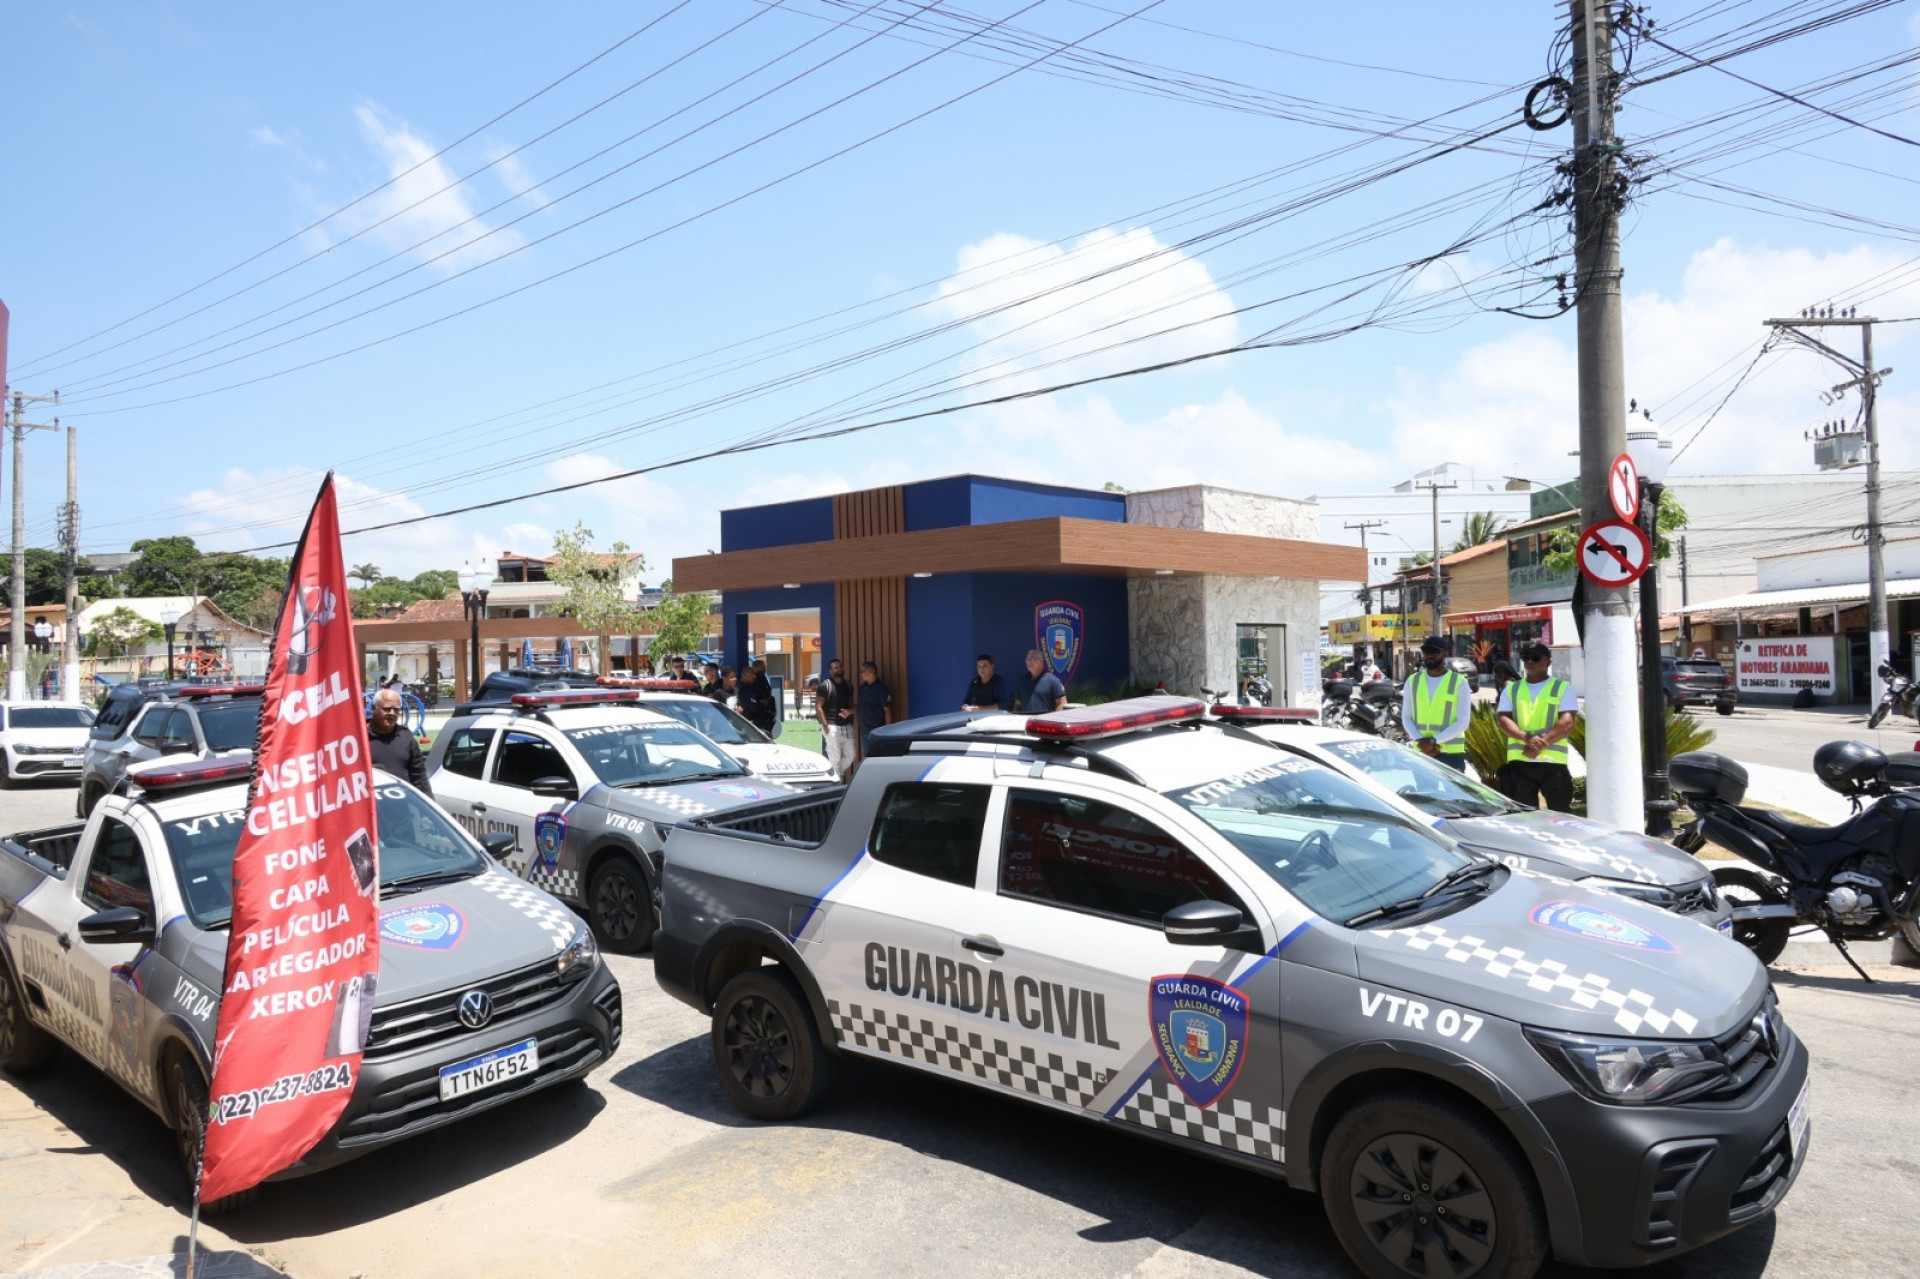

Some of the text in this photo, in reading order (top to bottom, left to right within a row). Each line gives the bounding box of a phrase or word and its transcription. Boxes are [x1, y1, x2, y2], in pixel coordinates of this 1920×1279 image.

[1040, 606, 1080, 620] GUARDA CIVIL
[1740, 661, 1830, 674] MOTORES ARARUAMA
[1758, 644, 1794, 657] RETIFICA
[1796, 644, 1807, 657] DE
[277, 671, 350, 726] CELL
[570, 728, 604, 740] VTR
[257, 735, 360, 797] NSERTO
[247, 770, 370, 836] CELULAR
[1182, 781, 1236, 805] VTR
[605, 812, 646, 834] VTR 06
[265, 838, 327, 875] FONE
[269, 875, 329, 910] CAPA
[244, 903, 350, 954] PELÍCULA
[226, 933, 366, 993] AREGADOR
[173, 976, 216, 1022] VTR 04
[250, 979, 336, 1019] XEROX
[864, 942, 1121, 1050] GUARDA CIVIL
[1157, 983, 1241, 1012] GUARDA CIVIL
[1174, 999, 1222, 1018] LEALDADE
[1359, 987, 1484, 1044] VTR 07
[1157, 1023, 1187, 1080] SEGURANÇA
[1211, 1039, 1239, 1086] HARMONIA
[450, 1053, 529, 1095] TTN6F52
